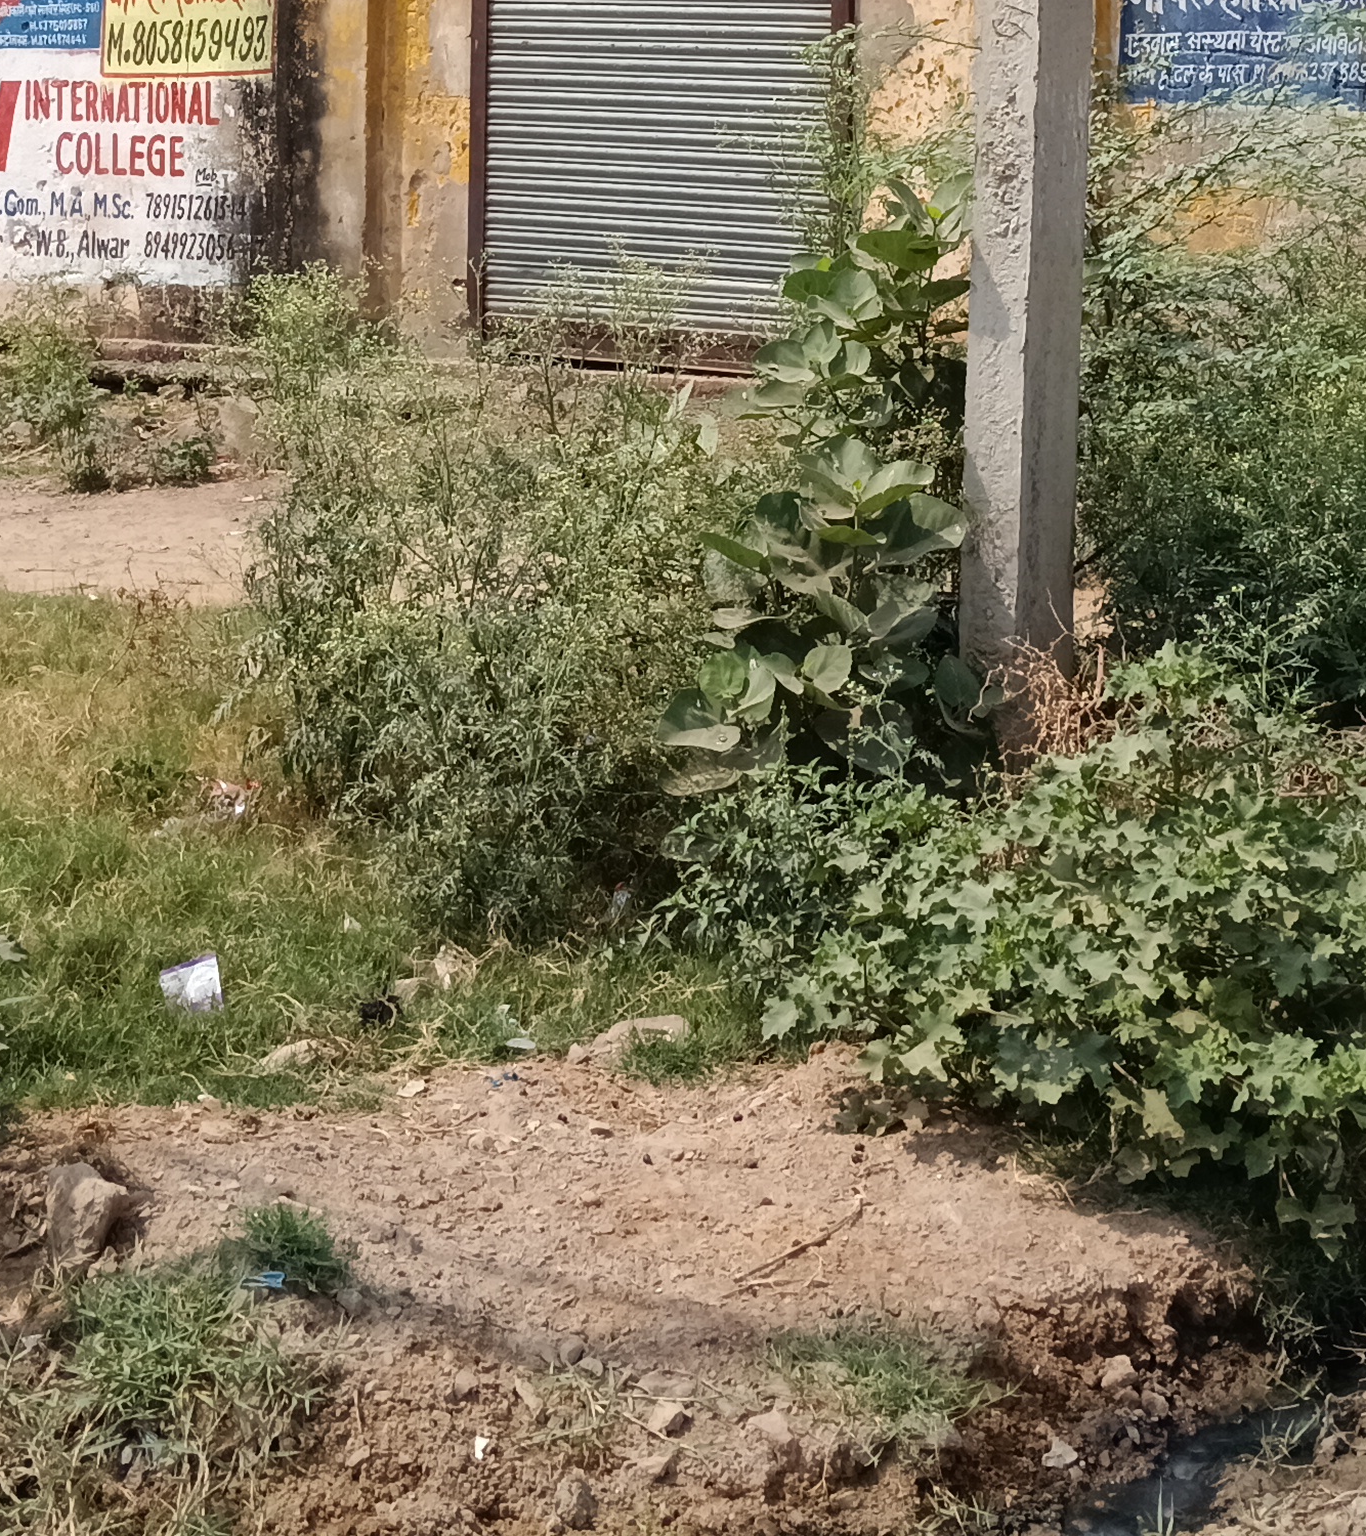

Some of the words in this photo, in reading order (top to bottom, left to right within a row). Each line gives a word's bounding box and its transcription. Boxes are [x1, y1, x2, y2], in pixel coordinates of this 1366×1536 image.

[1198, 56, 1217, 84] के
[1216, 64, 1251, 85] पास
[25, 78, 221, 126] INTERNATIONAL
[55, 131, 186, 177] COLLEGE
[92, 192, 135, 220] M.Sc.
[76, 229, 131, 261] Alwar
